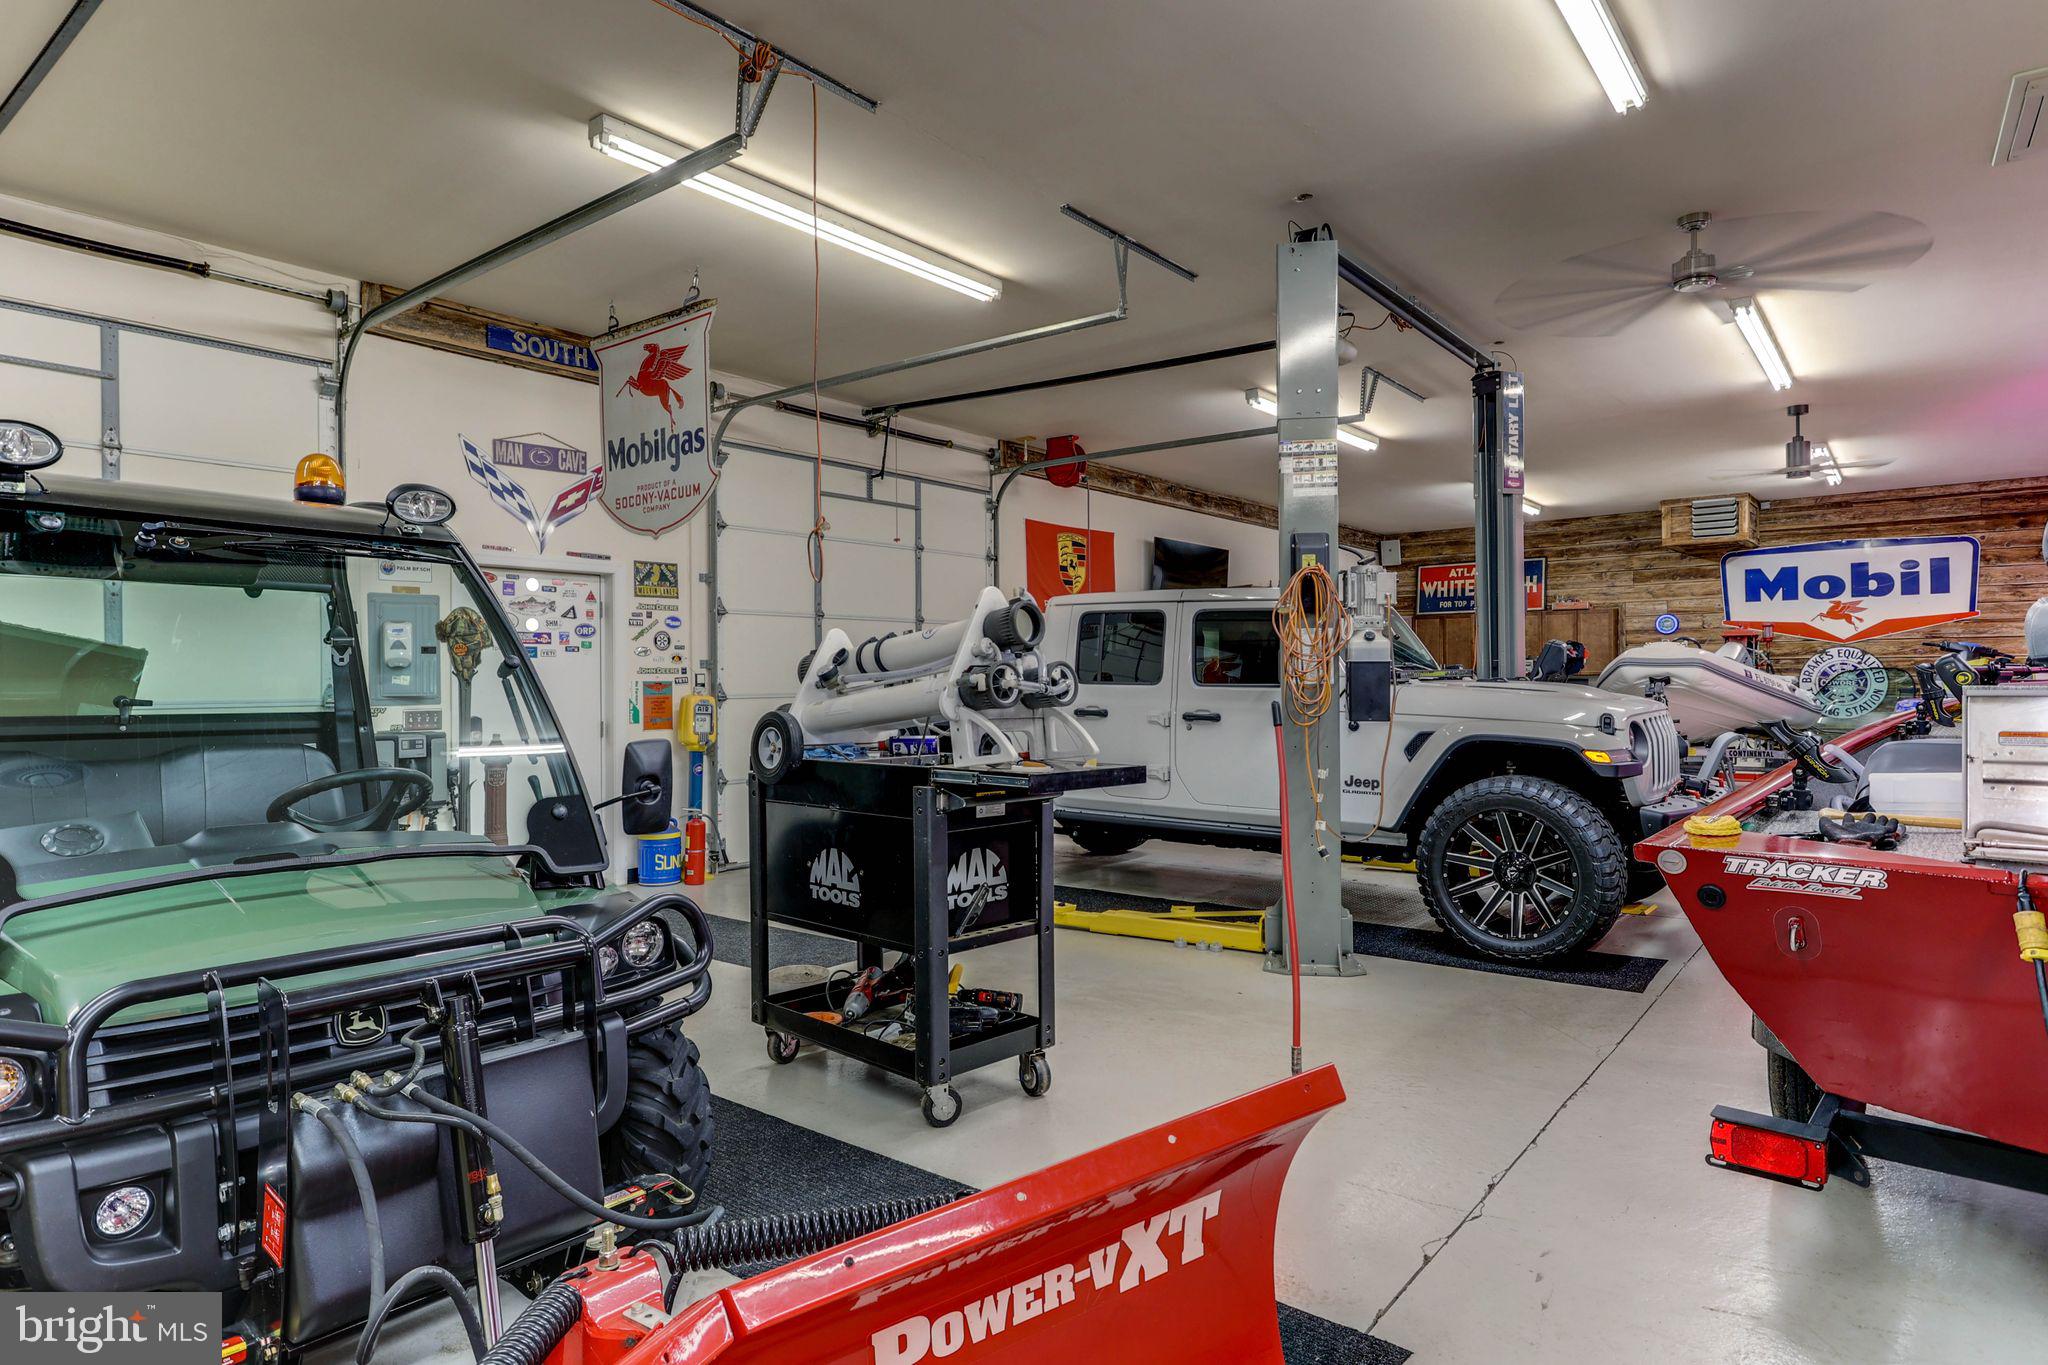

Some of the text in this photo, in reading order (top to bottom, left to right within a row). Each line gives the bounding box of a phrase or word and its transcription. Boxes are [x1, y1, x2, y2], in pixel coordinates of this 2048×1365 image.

[512, 331, 588, 368] SOUTH
[494, 441, 586, 473] MAN CAVE
[608, 427, 705, 472] Mobilgas
[615, 483, 701, 510] SOCONY-VACUUM
[636, 481, 662, 491] PRODUCT
[663, 480, 671, 488] OF
[642, 503, 671, 514] COMPANY
[1422, 579, 1475, 598] WHITE
[1745, 557, 1950, 602] Mobil
[1455, 600, 1467, 608] TOP
[576, 627, 594, 635] ORP
[1802, 651, 1834, 683] BRAKES
[1845, 688, 1885, 717] STATION
[1728, 750, 1774, 758] CONTINENTAL
[1344, 775, 1380, 790] Jeep
[810, 848, 860, 892] MAC
[948, 848, 1007, 894] MAC
[810, 884, 860, 908] TOOLS
